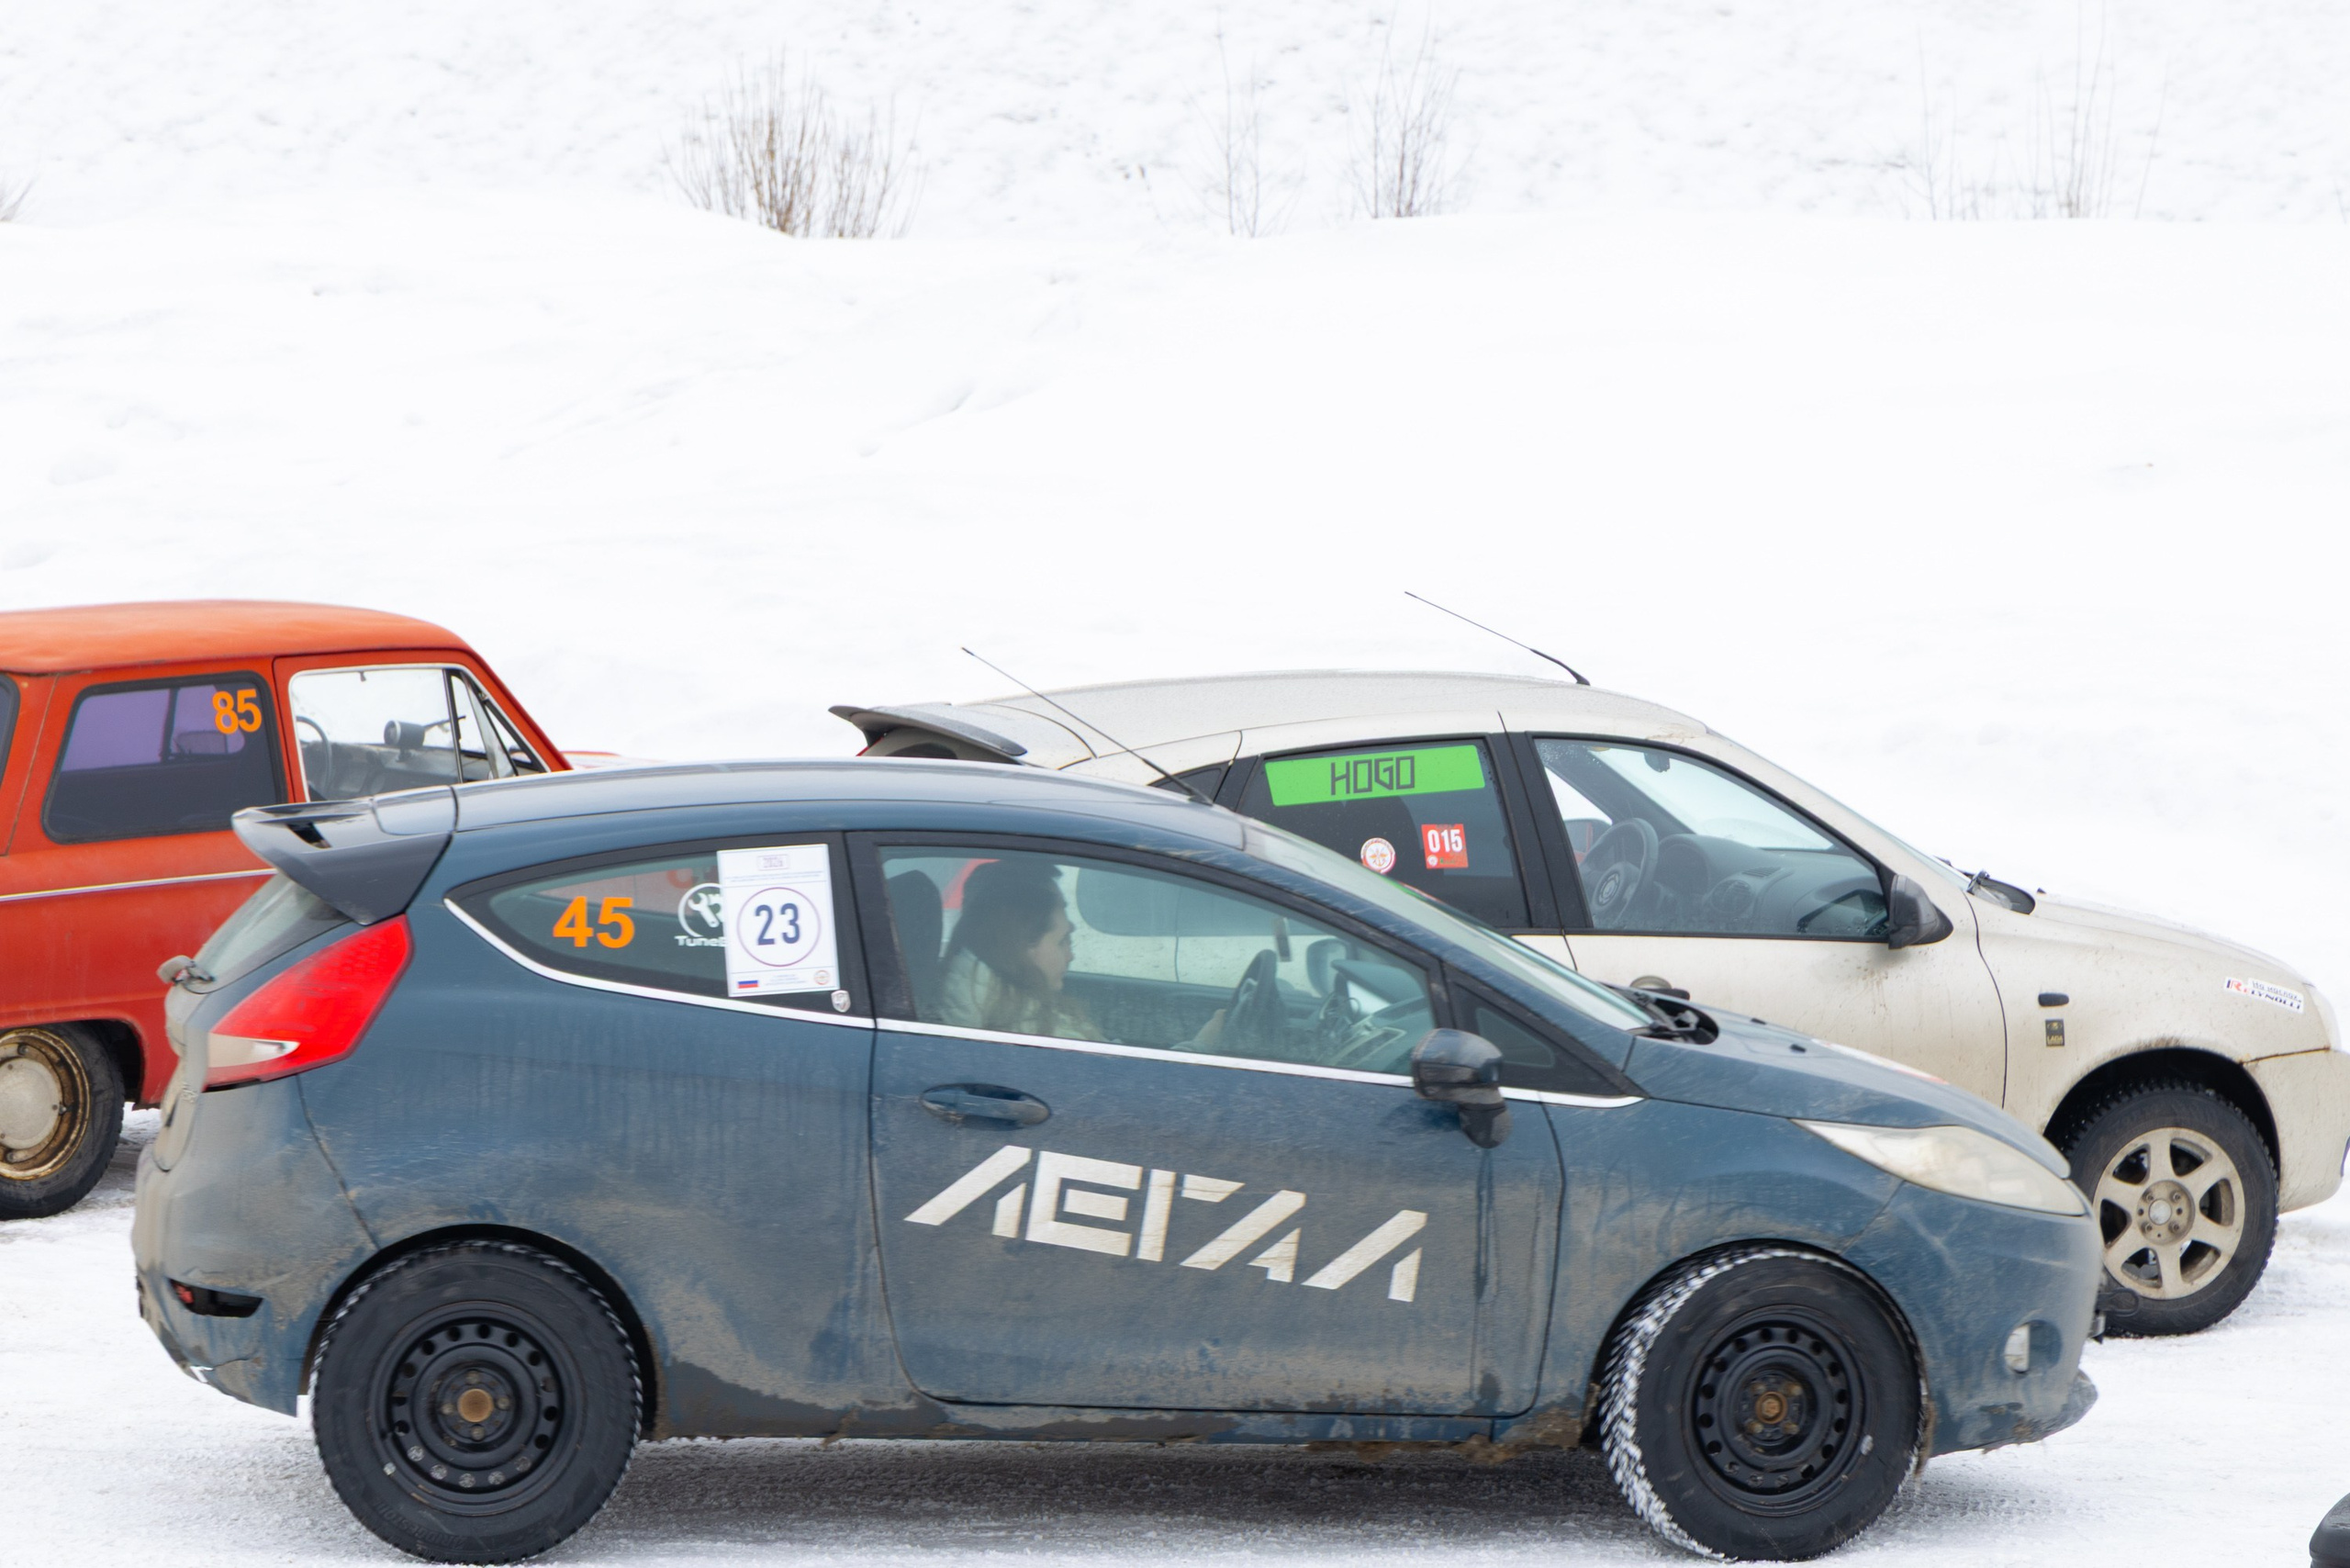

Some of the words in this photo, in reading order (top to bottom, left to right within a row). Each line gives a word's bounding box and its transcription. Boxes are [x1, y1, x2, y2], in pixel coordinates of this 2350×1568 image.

[211, 689, 263, 735] 85
[1427, 829, 1463, 854] 015
[553, 895, 635, 949] 45
[755, 902, 801, 946] 23
